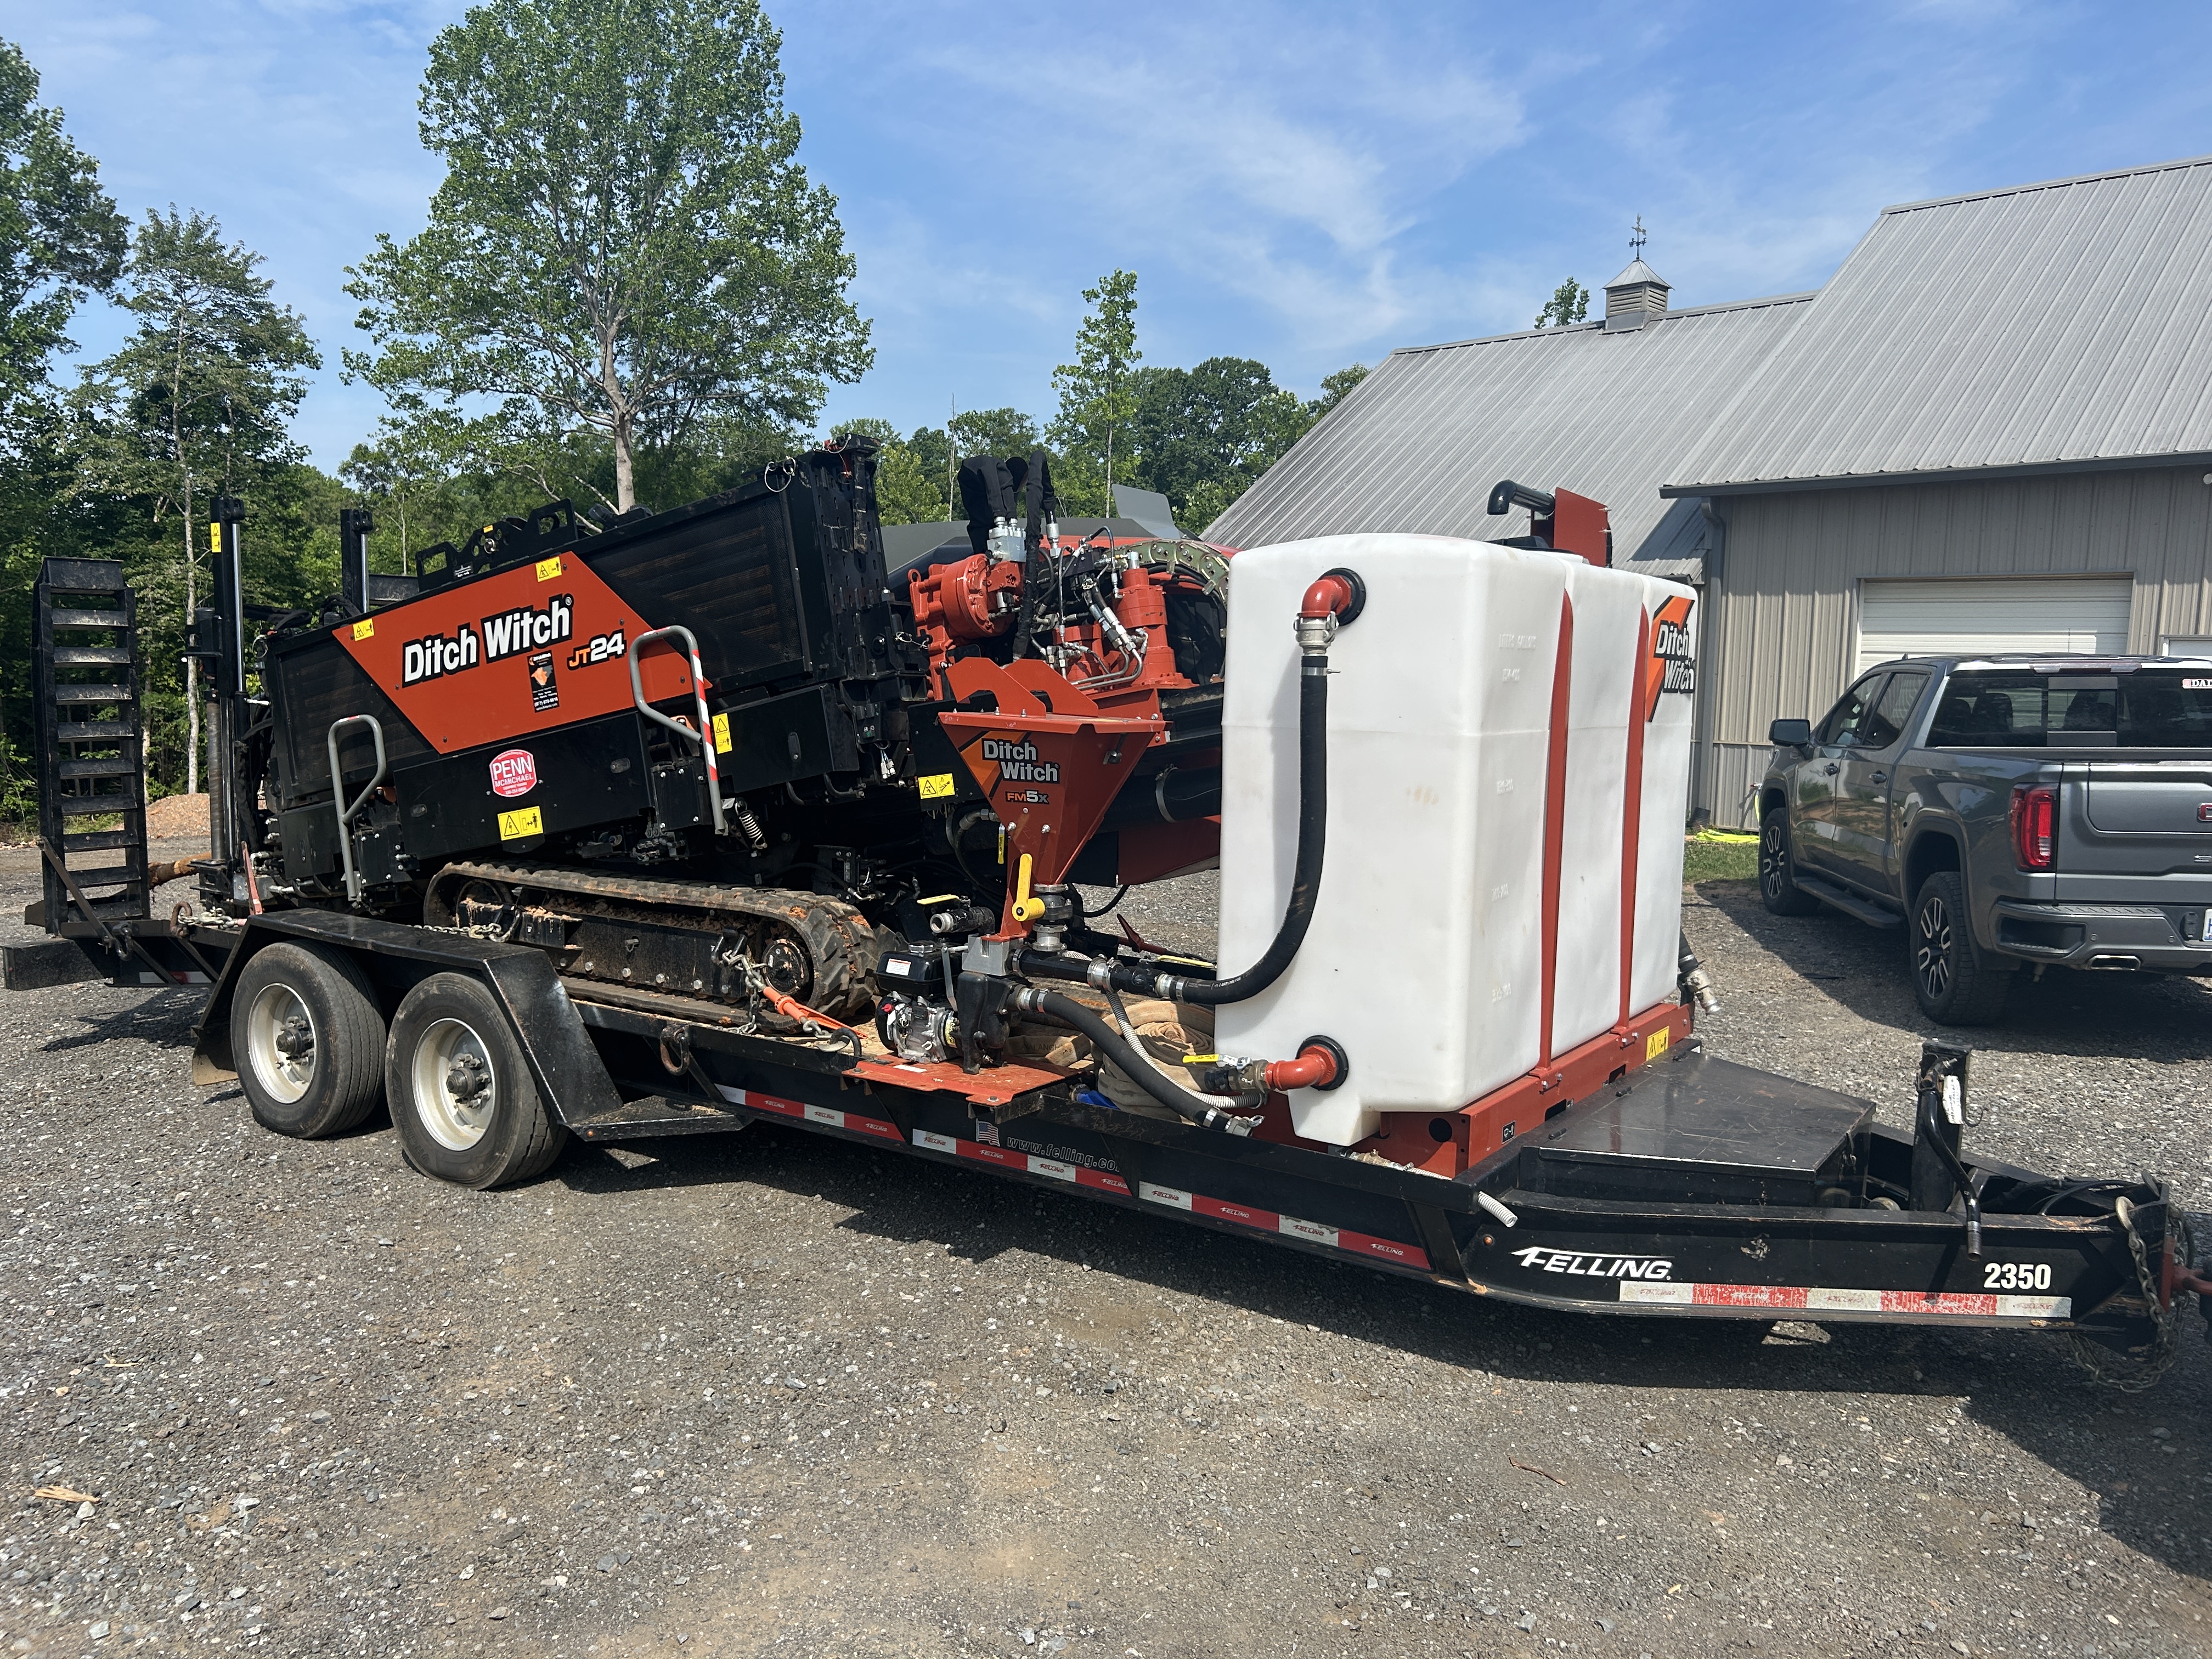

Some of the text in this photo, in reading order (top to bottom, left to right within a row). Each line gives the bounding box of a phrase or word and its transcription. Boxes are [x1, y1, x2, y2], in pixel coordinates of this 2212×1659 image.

[405, 600, 569, 682] Ditch Witch
[1655, 624, 1689, 656] Ditch
[569, 633, 624, 667] JT24
[1664, 659, 1694, 690] Witch
[984, 741, 1036, 760] Ditch
[492, 755, 533, 780] PENN
[1001, 761, 1058, 781] Witch
[494, 773, 534, 787] MCMICHAEL
[1039, 1163, 1064, 1173] FELLING
[1102, 1178, 1127, 1189] FELLING
[1151, 1190, 1180, 1202] FELLING
[1220, 1206, 1250, 1219] FELLING
[1293, 1224, 1324, 1237] FELLING
[1370, 1243, 1404, 1256] FELLING
[1511, 1246, 1674, 1279] FELLING
[1984, 1262, 2051, 1290] 2350
